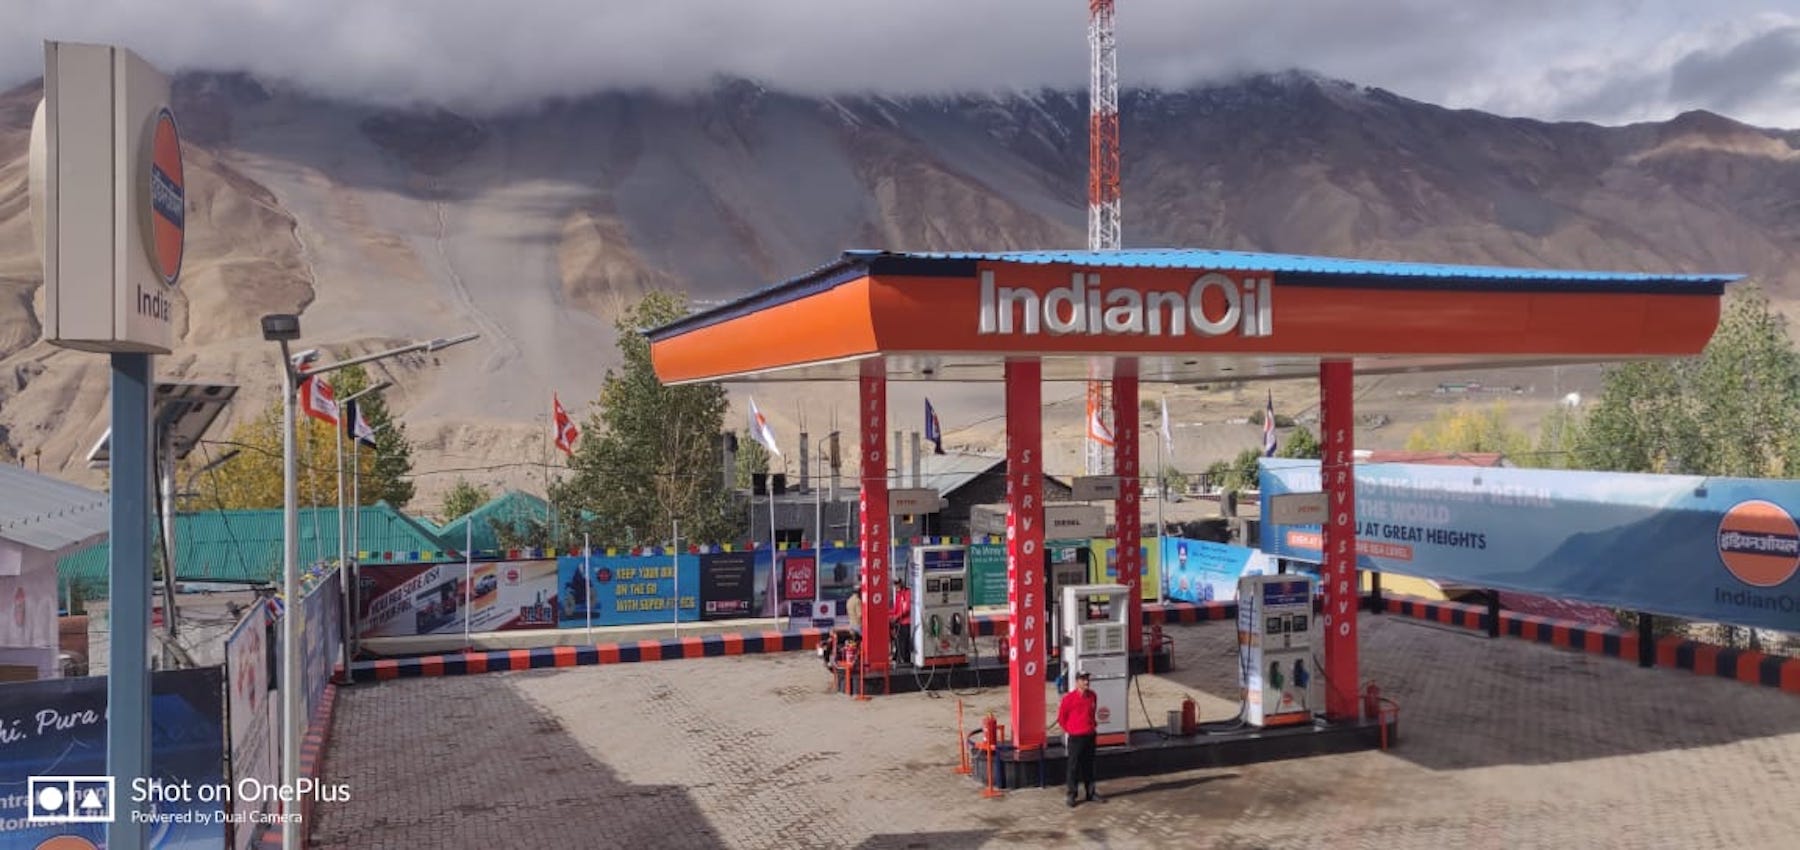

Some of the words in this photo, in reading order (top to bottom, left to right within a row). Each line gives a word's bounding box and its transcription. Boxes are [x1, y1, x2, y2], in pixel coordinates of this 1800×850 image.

[977, 270, 1272, 337] IndianOil
[869, 383, 880, 462] SERVO
[1021, 449, 1035, 555] SERVO
[1336, 429, 1348, 526] SERVO
[1359, 501, 1387, 518] THE
[1391, 503, 1450, 524] WORLD
[1054, 519, 1081, 527] DIESEL
[1365, 523, 1379, 538] AT
[1383, 525, 1423, 543] GREAT
[1427, 528, 1487, 549] HEIGHTS
[871, 524, 883, 605] SERVO
[1338, 540, 1350, 637] SERVO
[1714, 587, 1800, 613] IndianO
[1007, 556, 1018, 662] SERVO
[1023, 571, 1037, 677] SERVO
[35, 708, 98, 735] Pura
